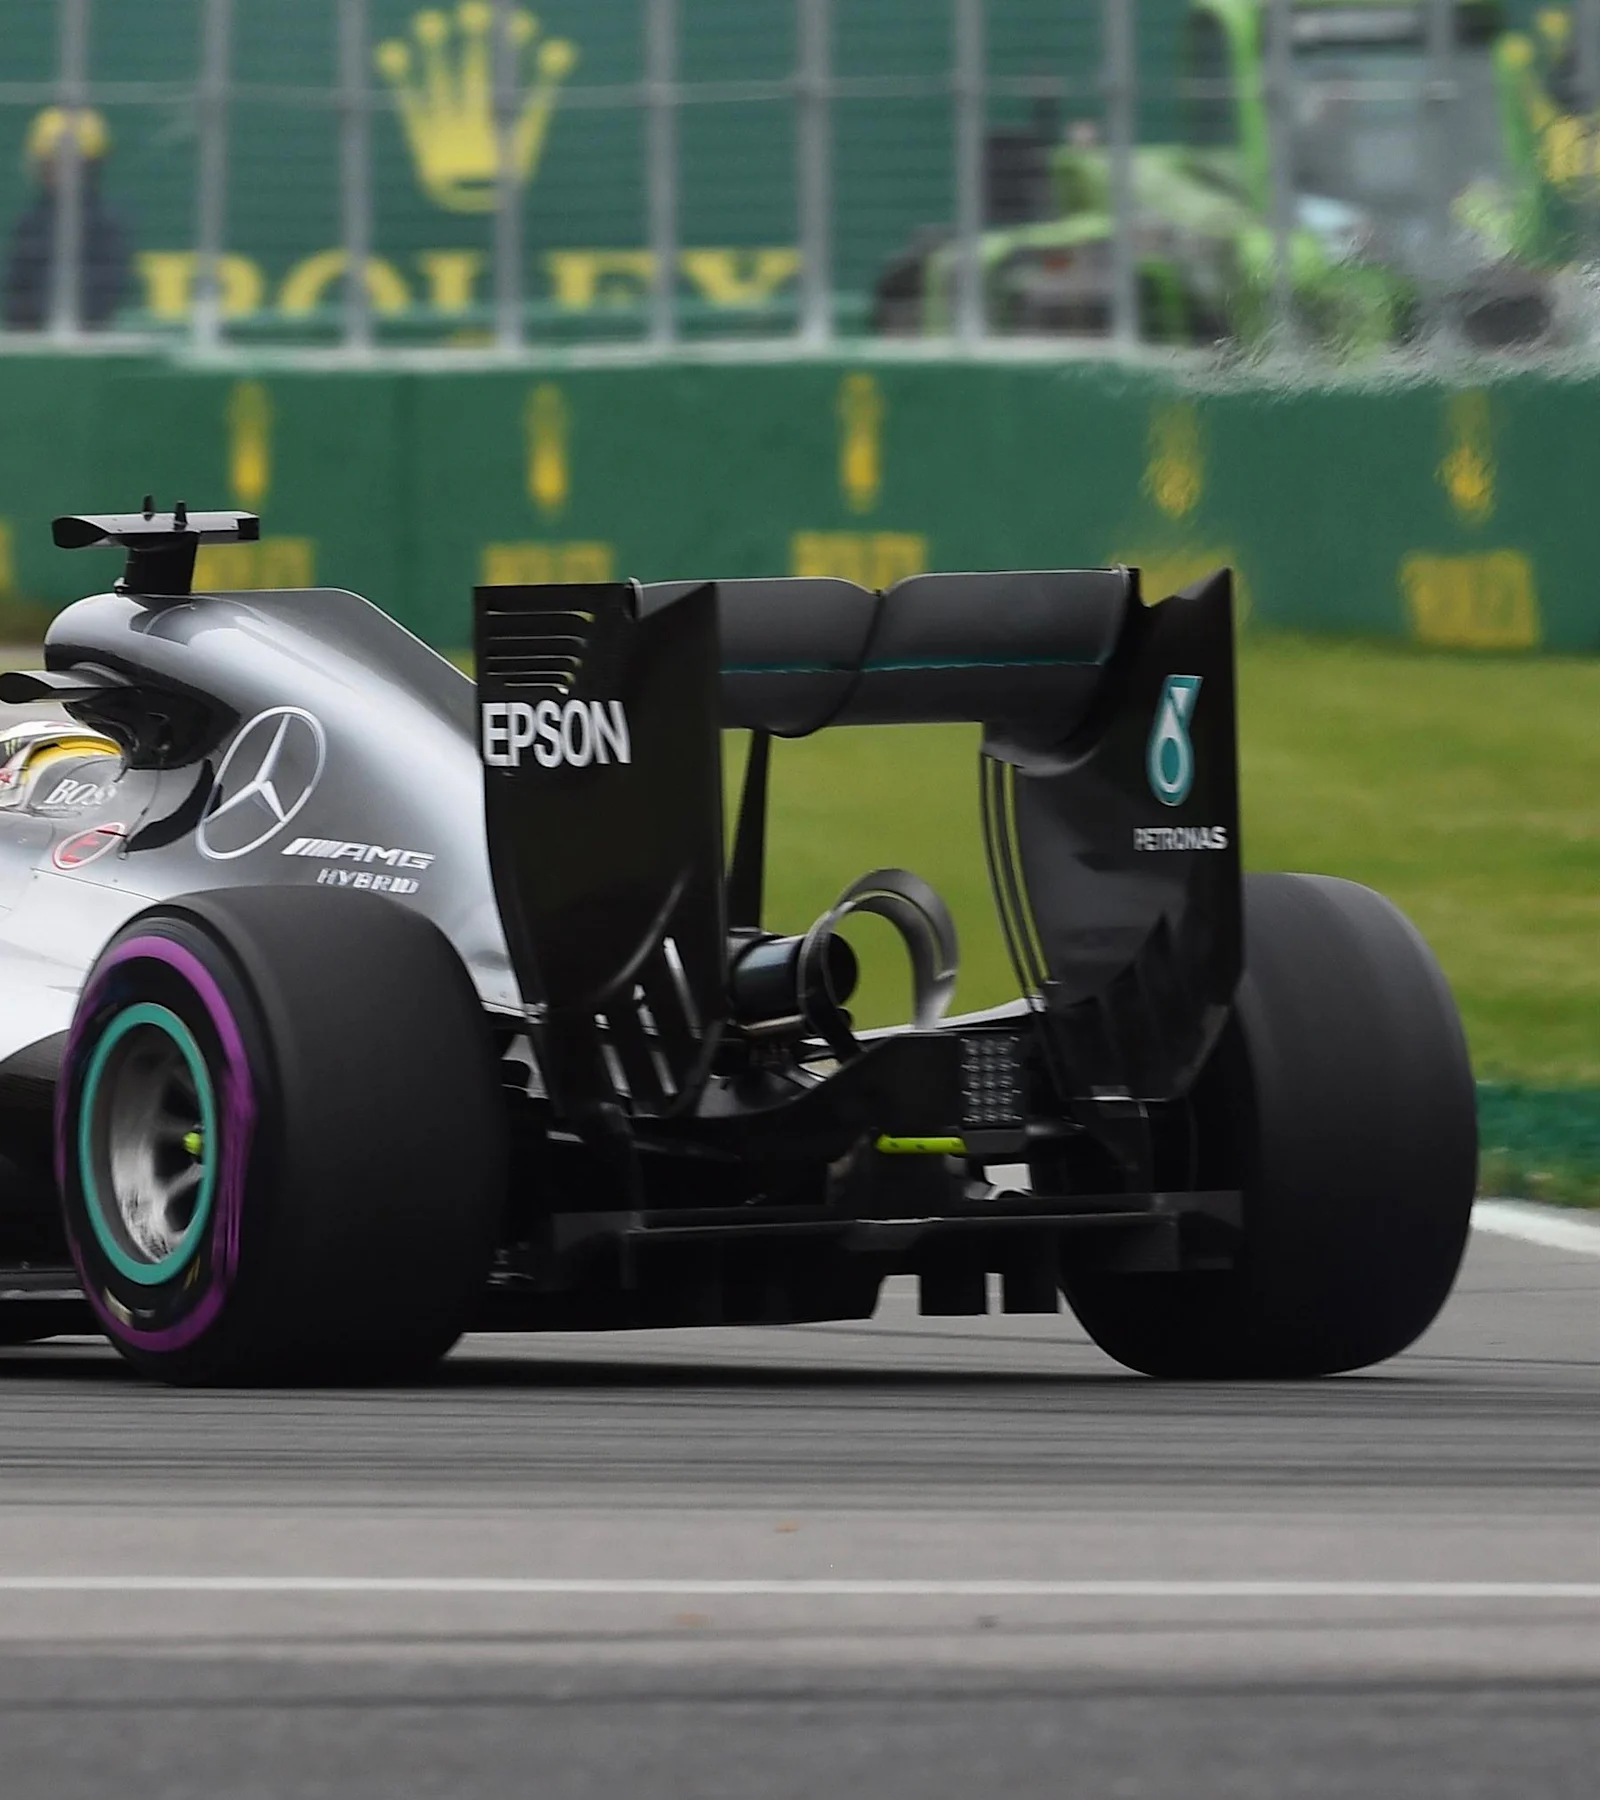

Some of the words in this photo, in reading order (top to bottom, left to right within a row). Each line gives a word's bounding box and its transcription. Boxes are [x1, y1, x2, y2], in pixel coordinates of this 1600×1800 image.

[481, 699, 632, 768] EPSON
[1132, 826, 1229, 851] PETRONAS
[330, 842, 437, 870] AMG
[316, 867, 420, 894] HYBRID
